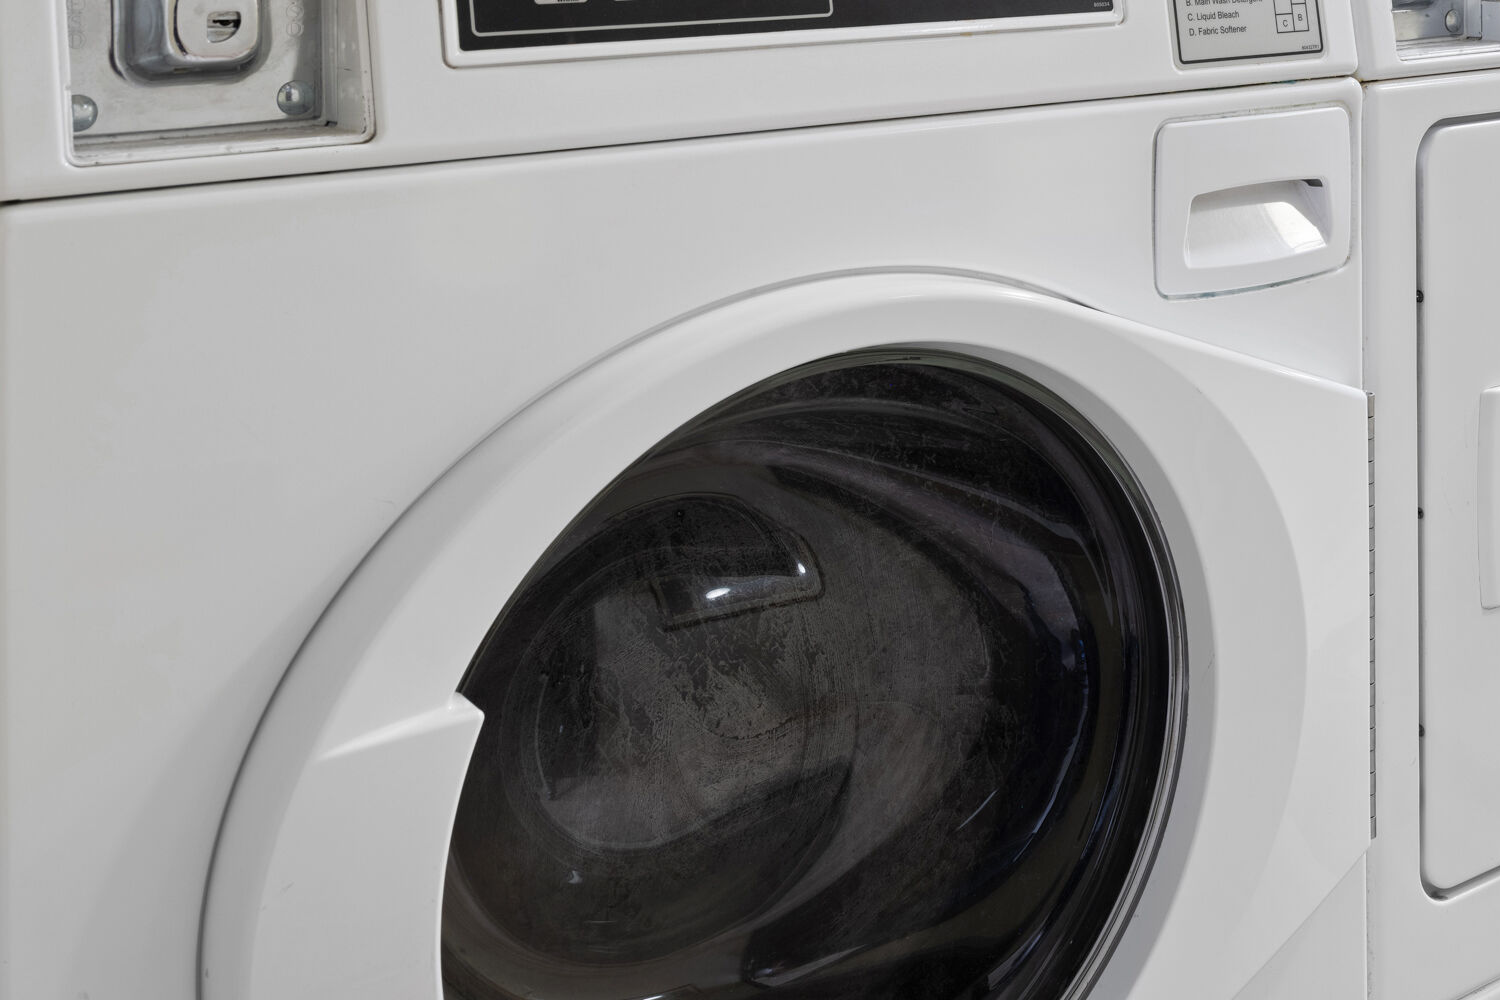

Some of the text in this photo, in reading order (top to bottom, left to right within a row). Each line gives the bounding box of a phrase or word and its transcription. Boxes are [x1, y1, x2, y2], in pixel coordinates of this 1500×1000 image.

[1187, 10, 1240, 22] C. Liquid Bleach
[1189, 25, 1247, 36] D. Fabric Softener
